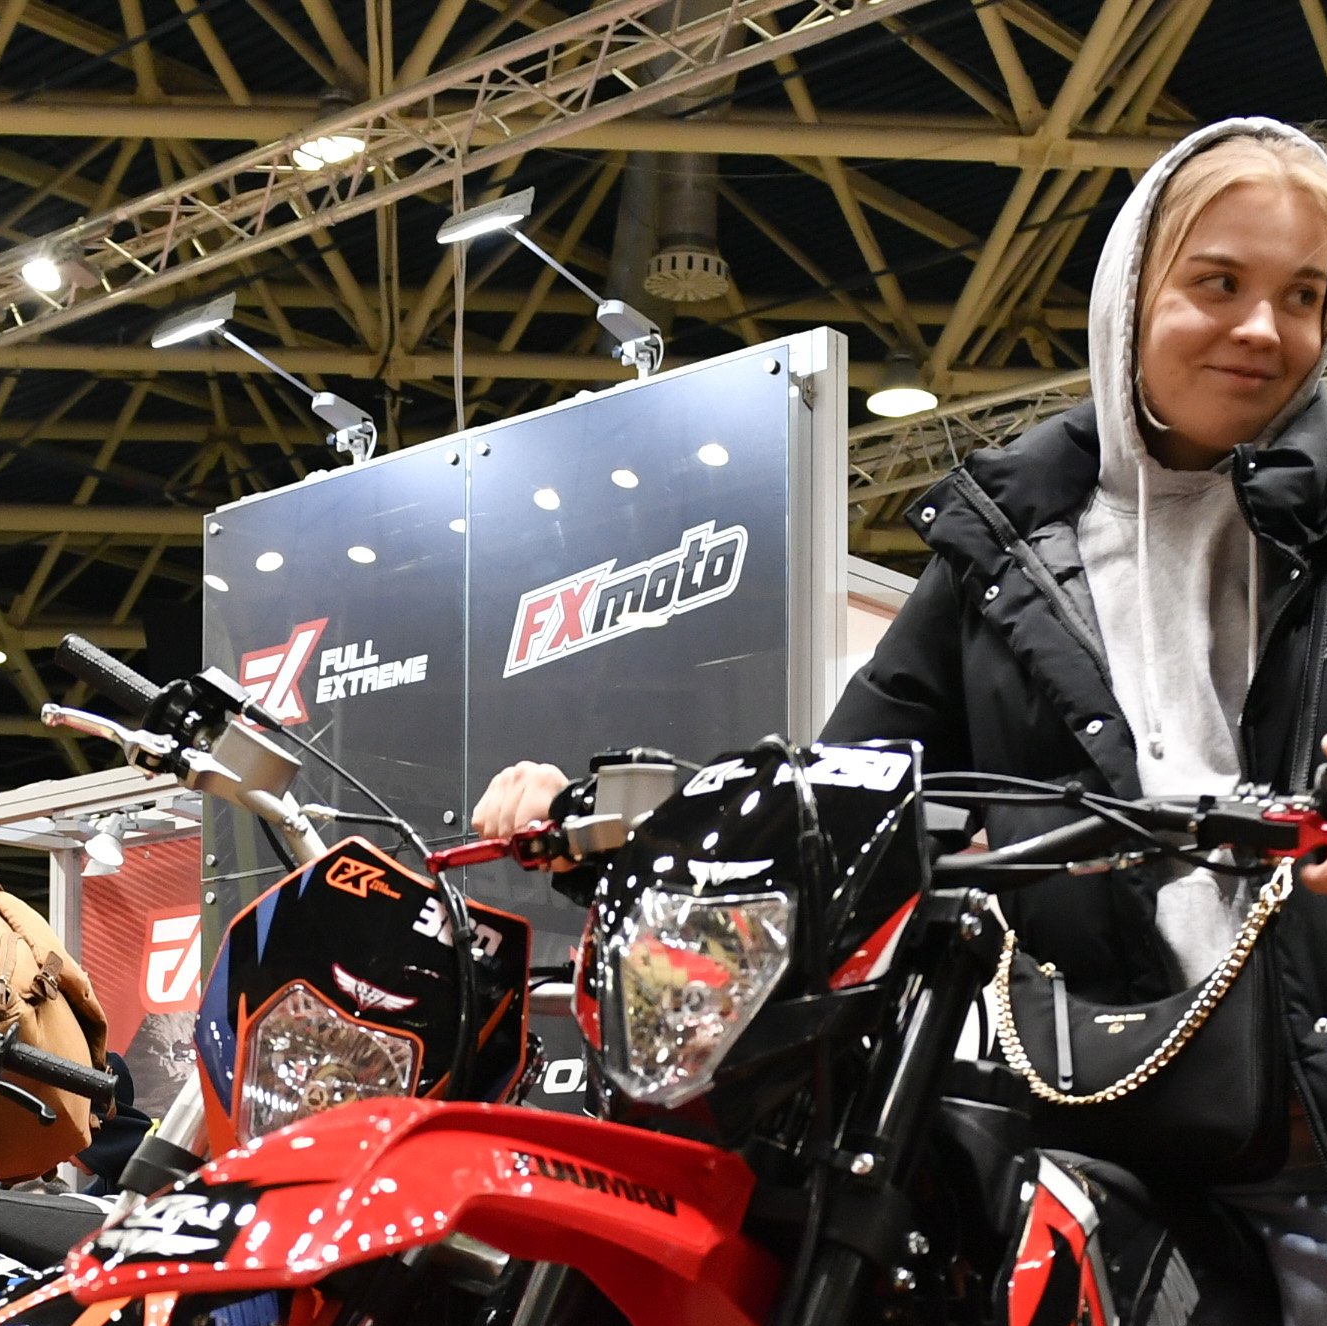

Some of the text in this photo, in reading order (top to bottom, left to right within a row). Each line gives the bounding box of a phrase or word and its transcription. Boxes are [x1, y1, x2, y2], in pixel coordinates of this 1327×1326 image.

[506, 522, 746, 674] FXmoto
[315, 654, 429, 704] EXTREME
[319, 640, 379, 676] FULL
[326, 856, 386, 898] FX
